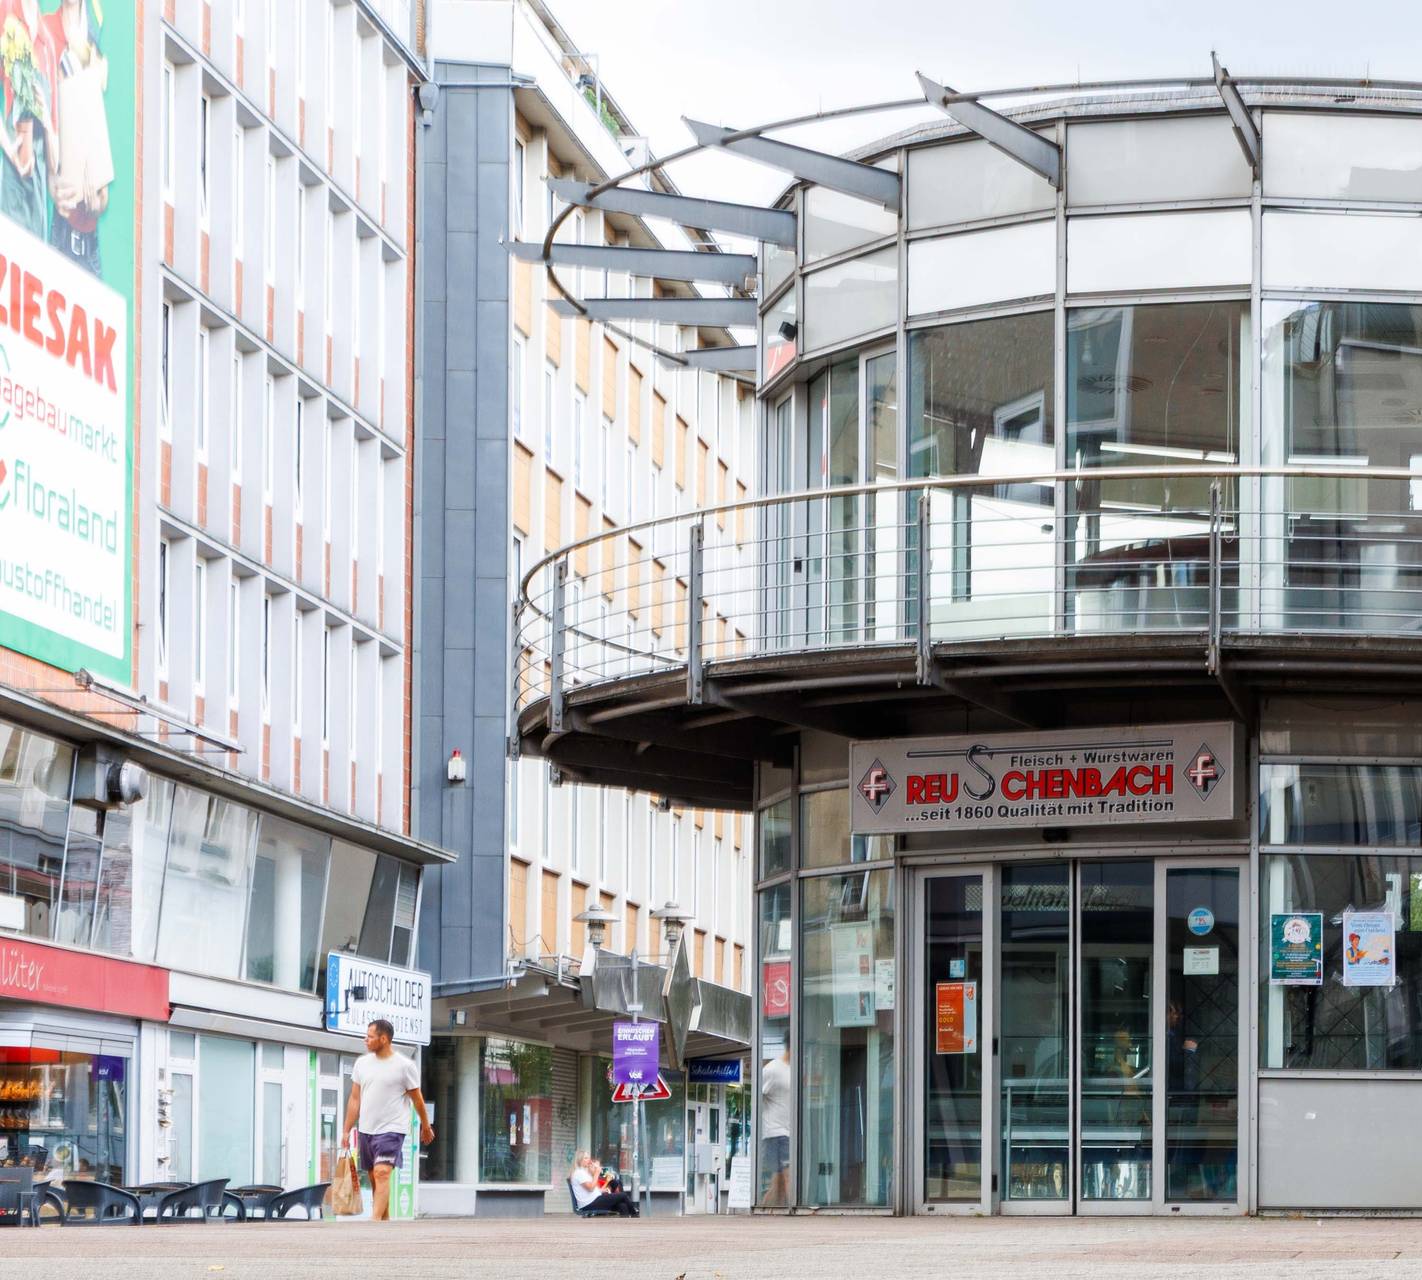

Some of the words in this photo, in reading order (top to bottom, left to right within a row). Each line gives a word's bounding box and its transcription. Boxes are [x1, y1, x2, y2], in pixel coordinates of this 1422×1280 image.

[0, 376, 117, 463] agebaumarkt
[14, 459, 117, 554] Floraland
[0, 559, 117, 632] ustoffhandel
[1010, 754, 1063, 767] Fleisch
[1084, 750, 1174, 764] Wurstwaren
[955, 806, 994, 819] 1860
[997, 802, 1063, 818] Qualität
[1067, 802, 1094, 814] mit
[1097, 799, 1174, 813] Tradition
